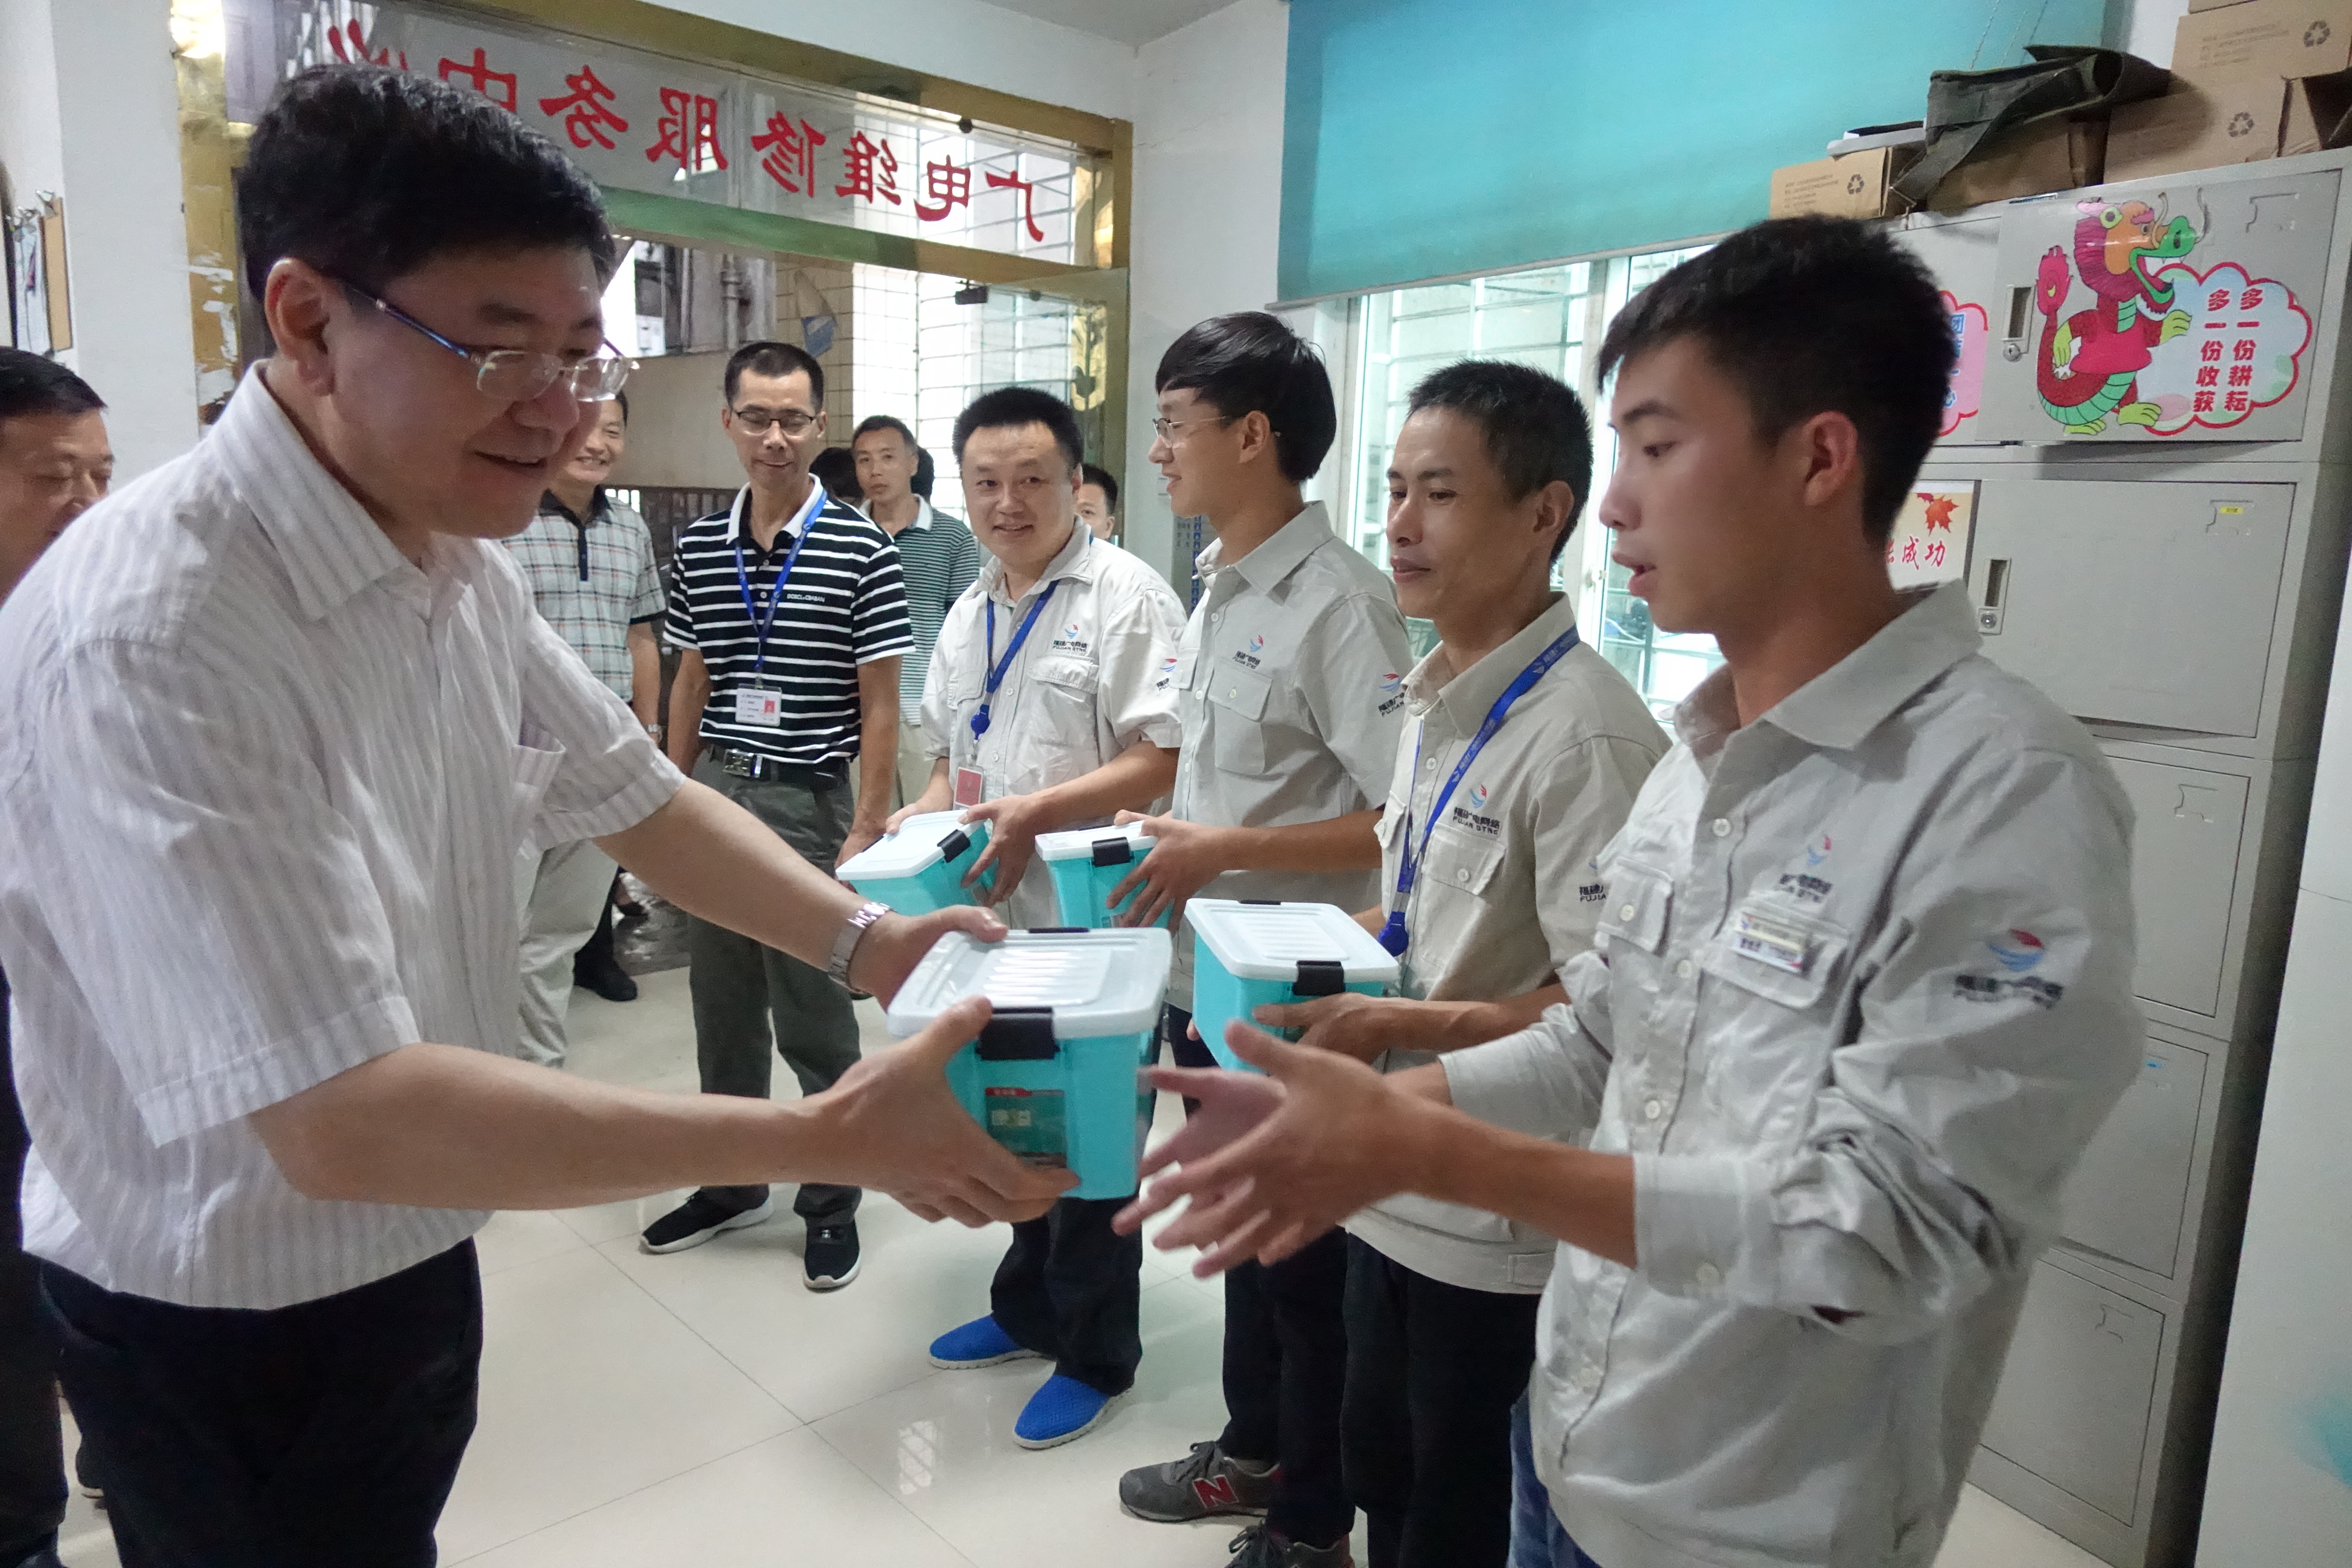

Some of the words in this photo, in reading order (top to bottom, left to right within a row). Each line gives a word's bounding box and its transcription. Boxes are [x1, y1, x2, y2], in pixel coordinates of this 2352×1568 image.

[2193, 289, 2230, 413] 多一份收获
[2224, 288, 2263, 411] 多一份耕耘
[1192, 1474, 1239, 1509] N
